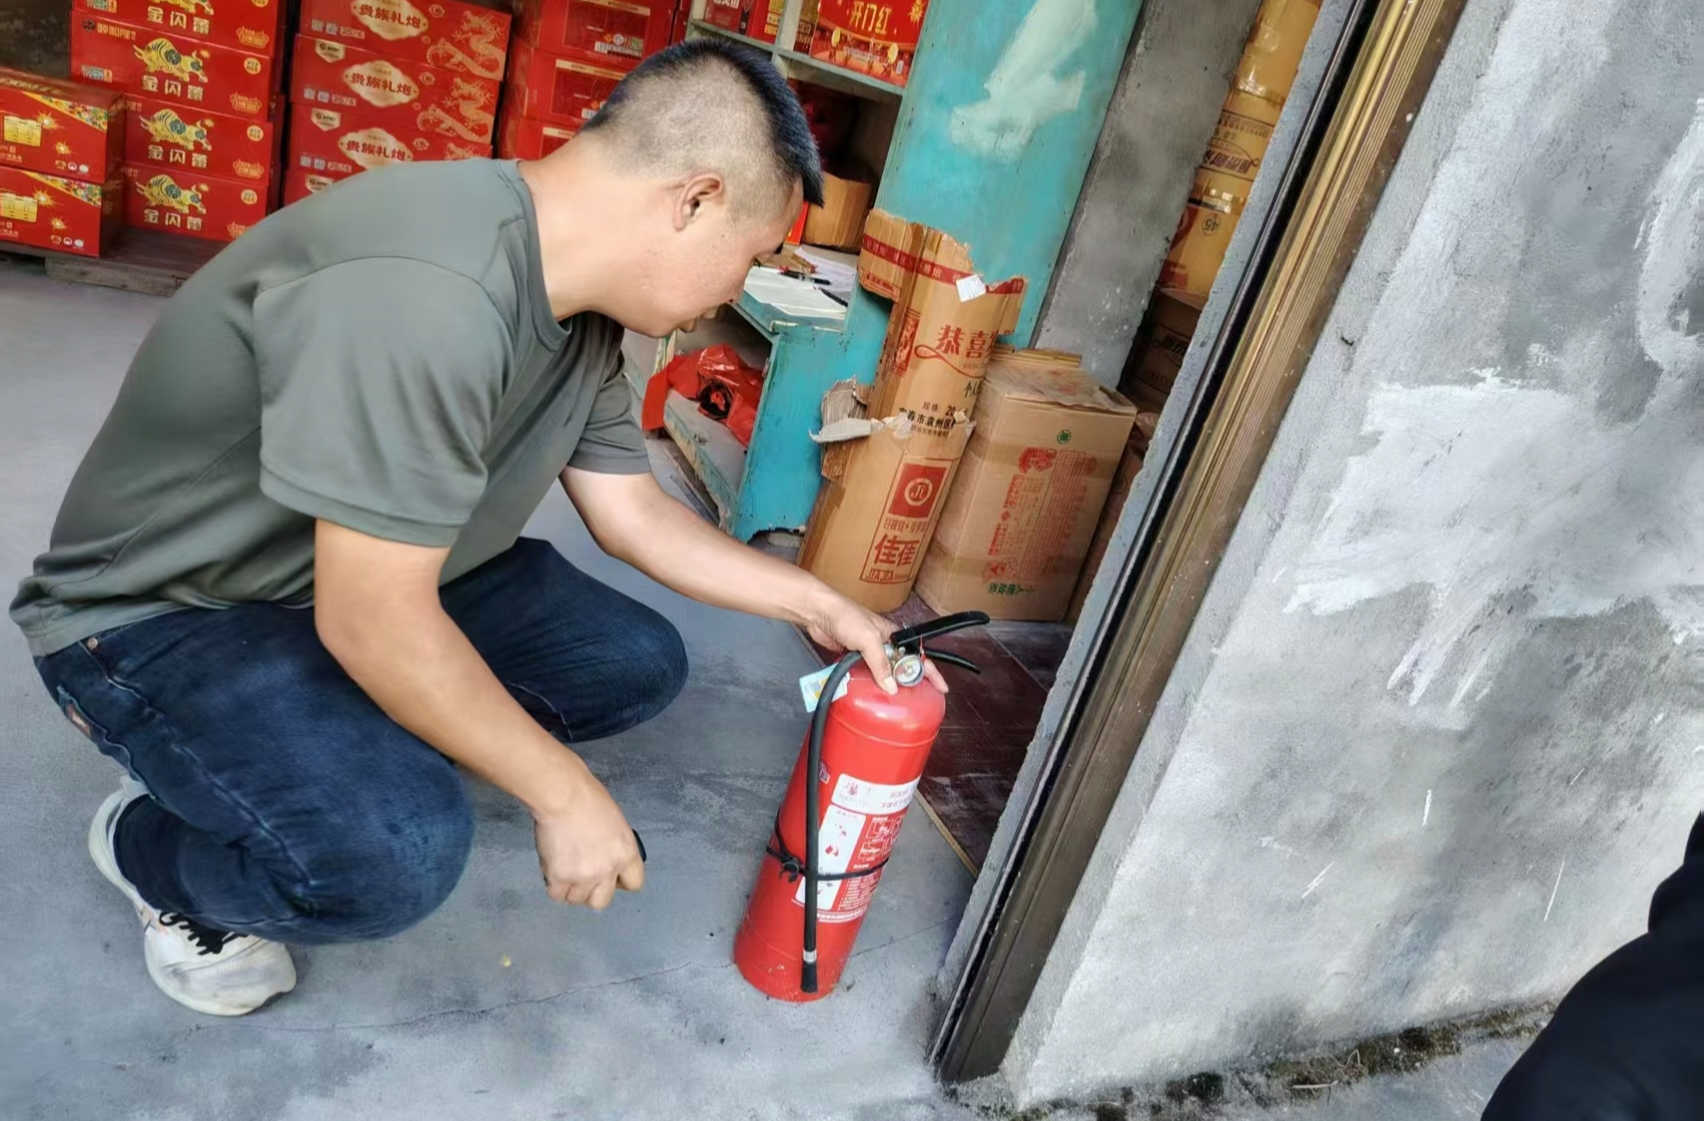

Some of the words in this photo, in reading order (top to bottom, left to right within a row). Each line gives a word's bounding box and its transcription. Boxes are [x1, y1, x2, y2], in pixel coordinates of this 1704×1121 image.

[359, 3, 421, 29] 贵族礼炮
[849, 0, 893, 35] 开门红
[350, 72, 412, 97] 贵族礼炮
[346, 140, 406, 162] 贵族礼炮
[1204, 219, 1219, 232] 45
[873, 533, 921, 567] 佳佳
